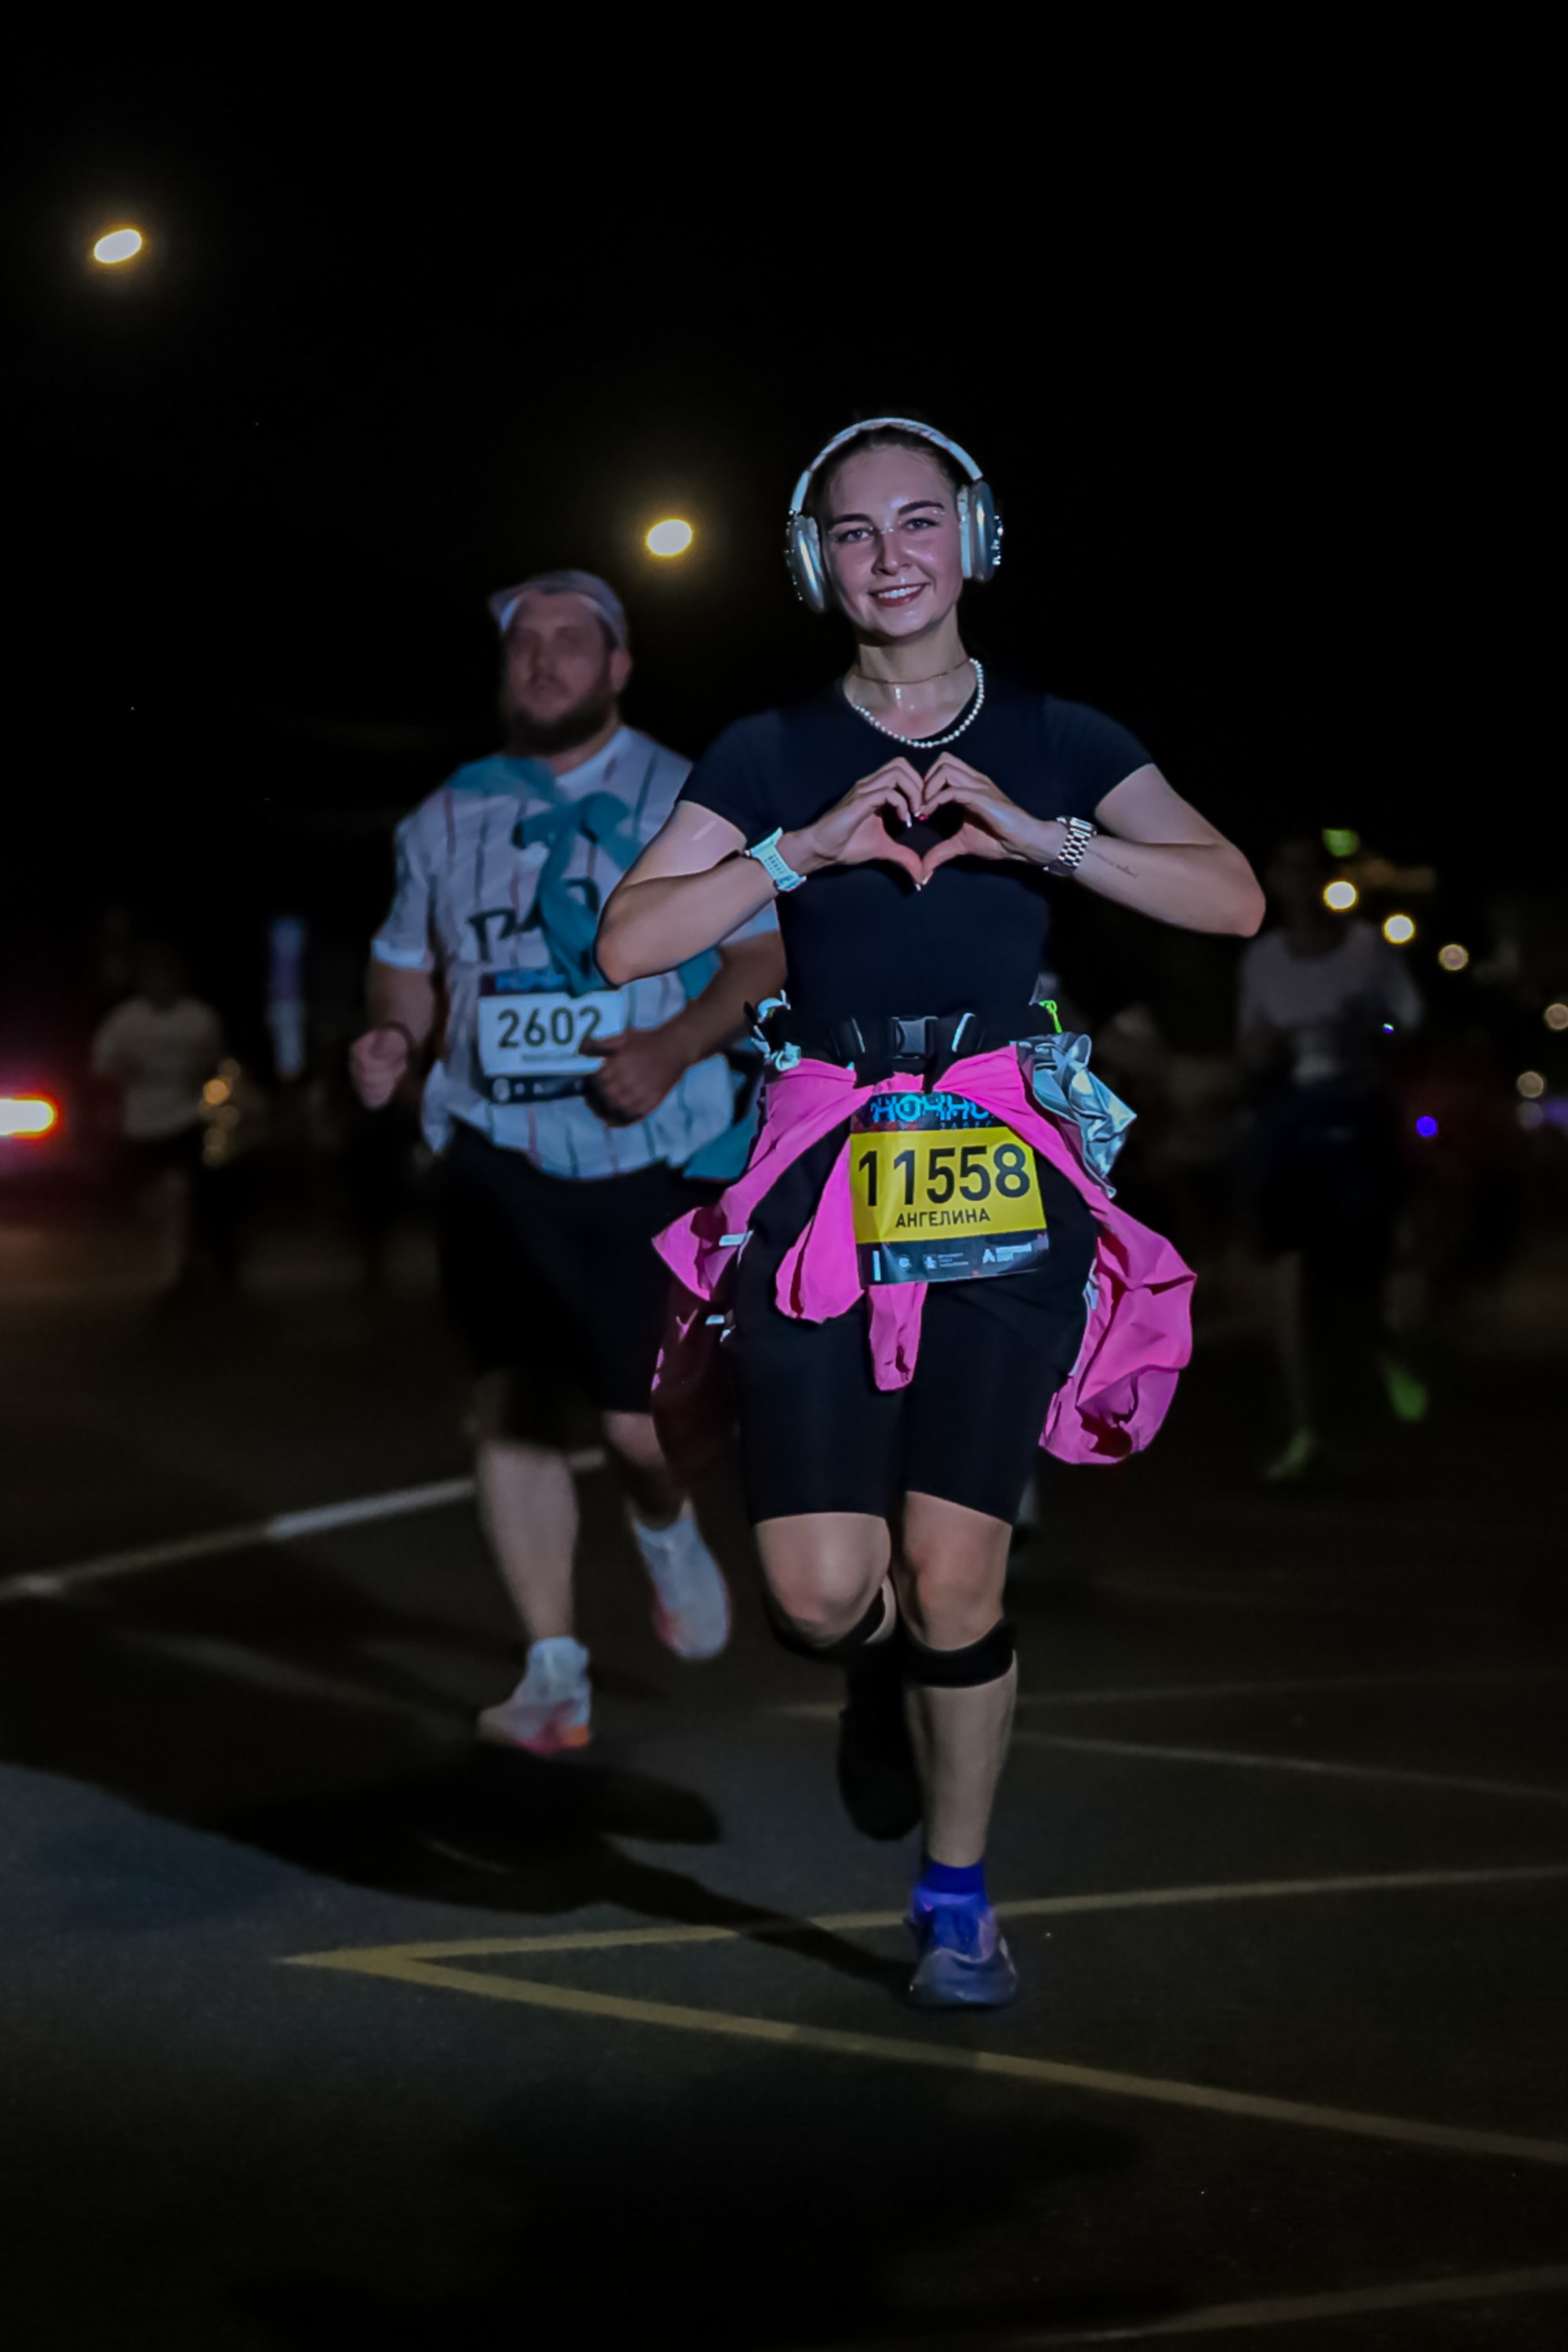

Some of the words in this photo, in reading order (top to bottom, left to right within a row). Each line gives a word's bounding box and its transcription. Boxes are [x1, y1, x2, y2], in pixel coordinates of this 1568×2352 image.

[497, 1005, 602, 1049] 2602
[858, 1143, 1031, 1207] 11558
[895, 1207, 991, 1228] АНГЕЛИНА
